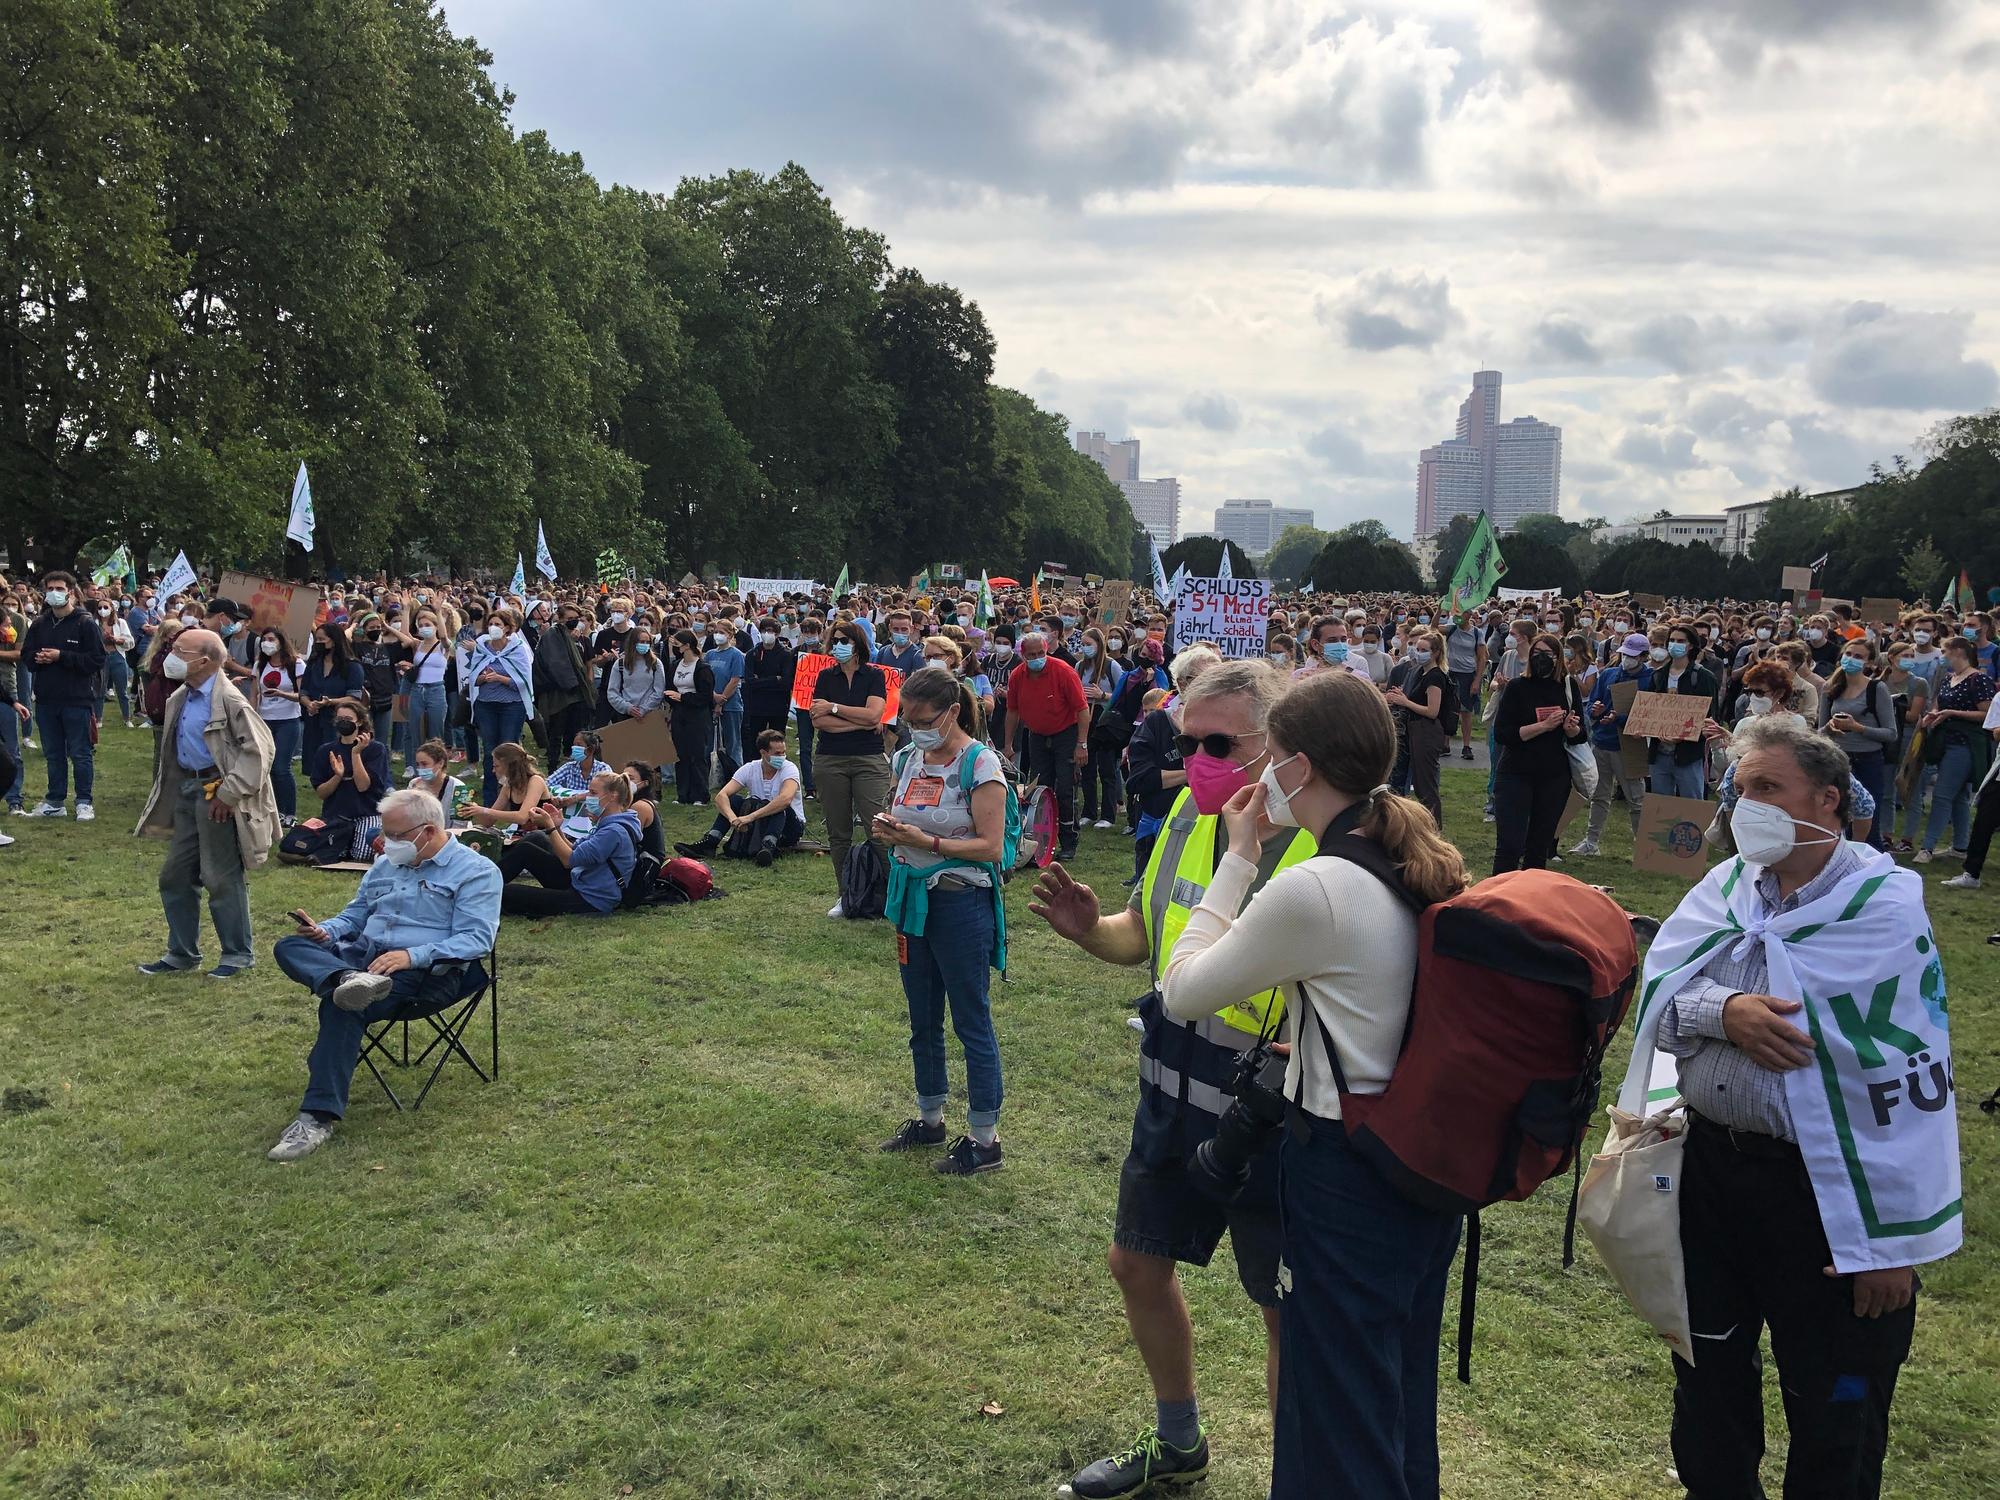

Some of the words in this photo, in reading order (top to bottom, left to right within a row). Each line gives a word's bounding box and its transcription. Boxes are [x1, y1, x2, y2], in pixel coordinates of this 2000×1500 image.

[1183, 578, 1263, 597] SCHLUSS
[1191, 593, 1218, 613] 54
[1176, 616, 1220, 640] jährl.
[1223, 625, 1262, 637] schädl.
[1867, 1053, 1954, 1127] FÜ
